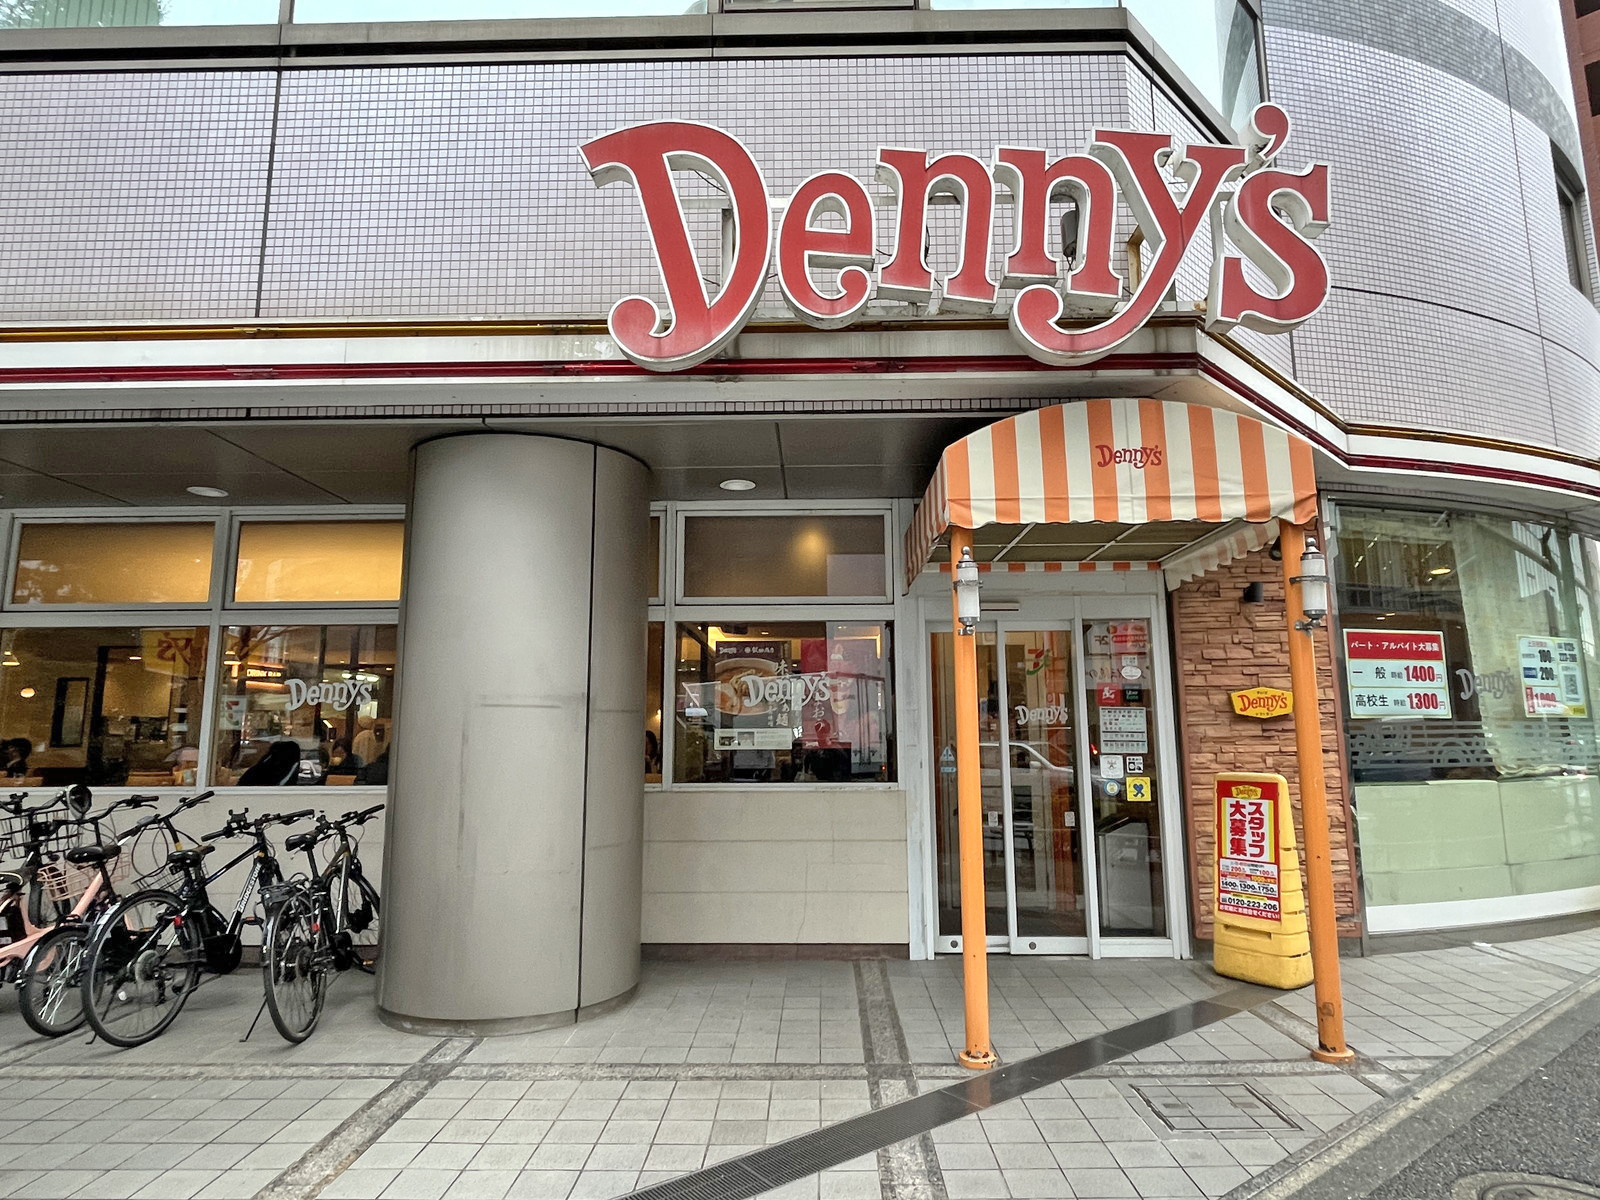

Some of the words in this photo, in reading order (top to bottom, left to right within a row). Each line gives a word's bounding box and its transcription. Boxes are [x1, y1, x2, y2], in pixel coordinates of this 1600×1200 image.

[578, 102, 1332, 372] Denny's
[1095, 444, 1162, 469] Denny's
[1351, 641, 1440, 652] パート・アルバイト大募集
[742, 672, 832, 708] Denny's
[1456, 667, 1515, 701] Denny's
[1237, 692, 1288, 712] Denny's
[1355, 694, 1389, 707] 高校生
[1015, 705, 1068, 725] Denny's
[1230, 800, 1247, 857] 大募集
[1248, 802, 1265, 858] スタッフ
[1227, 897, 1278, 911] 0120-223-206
